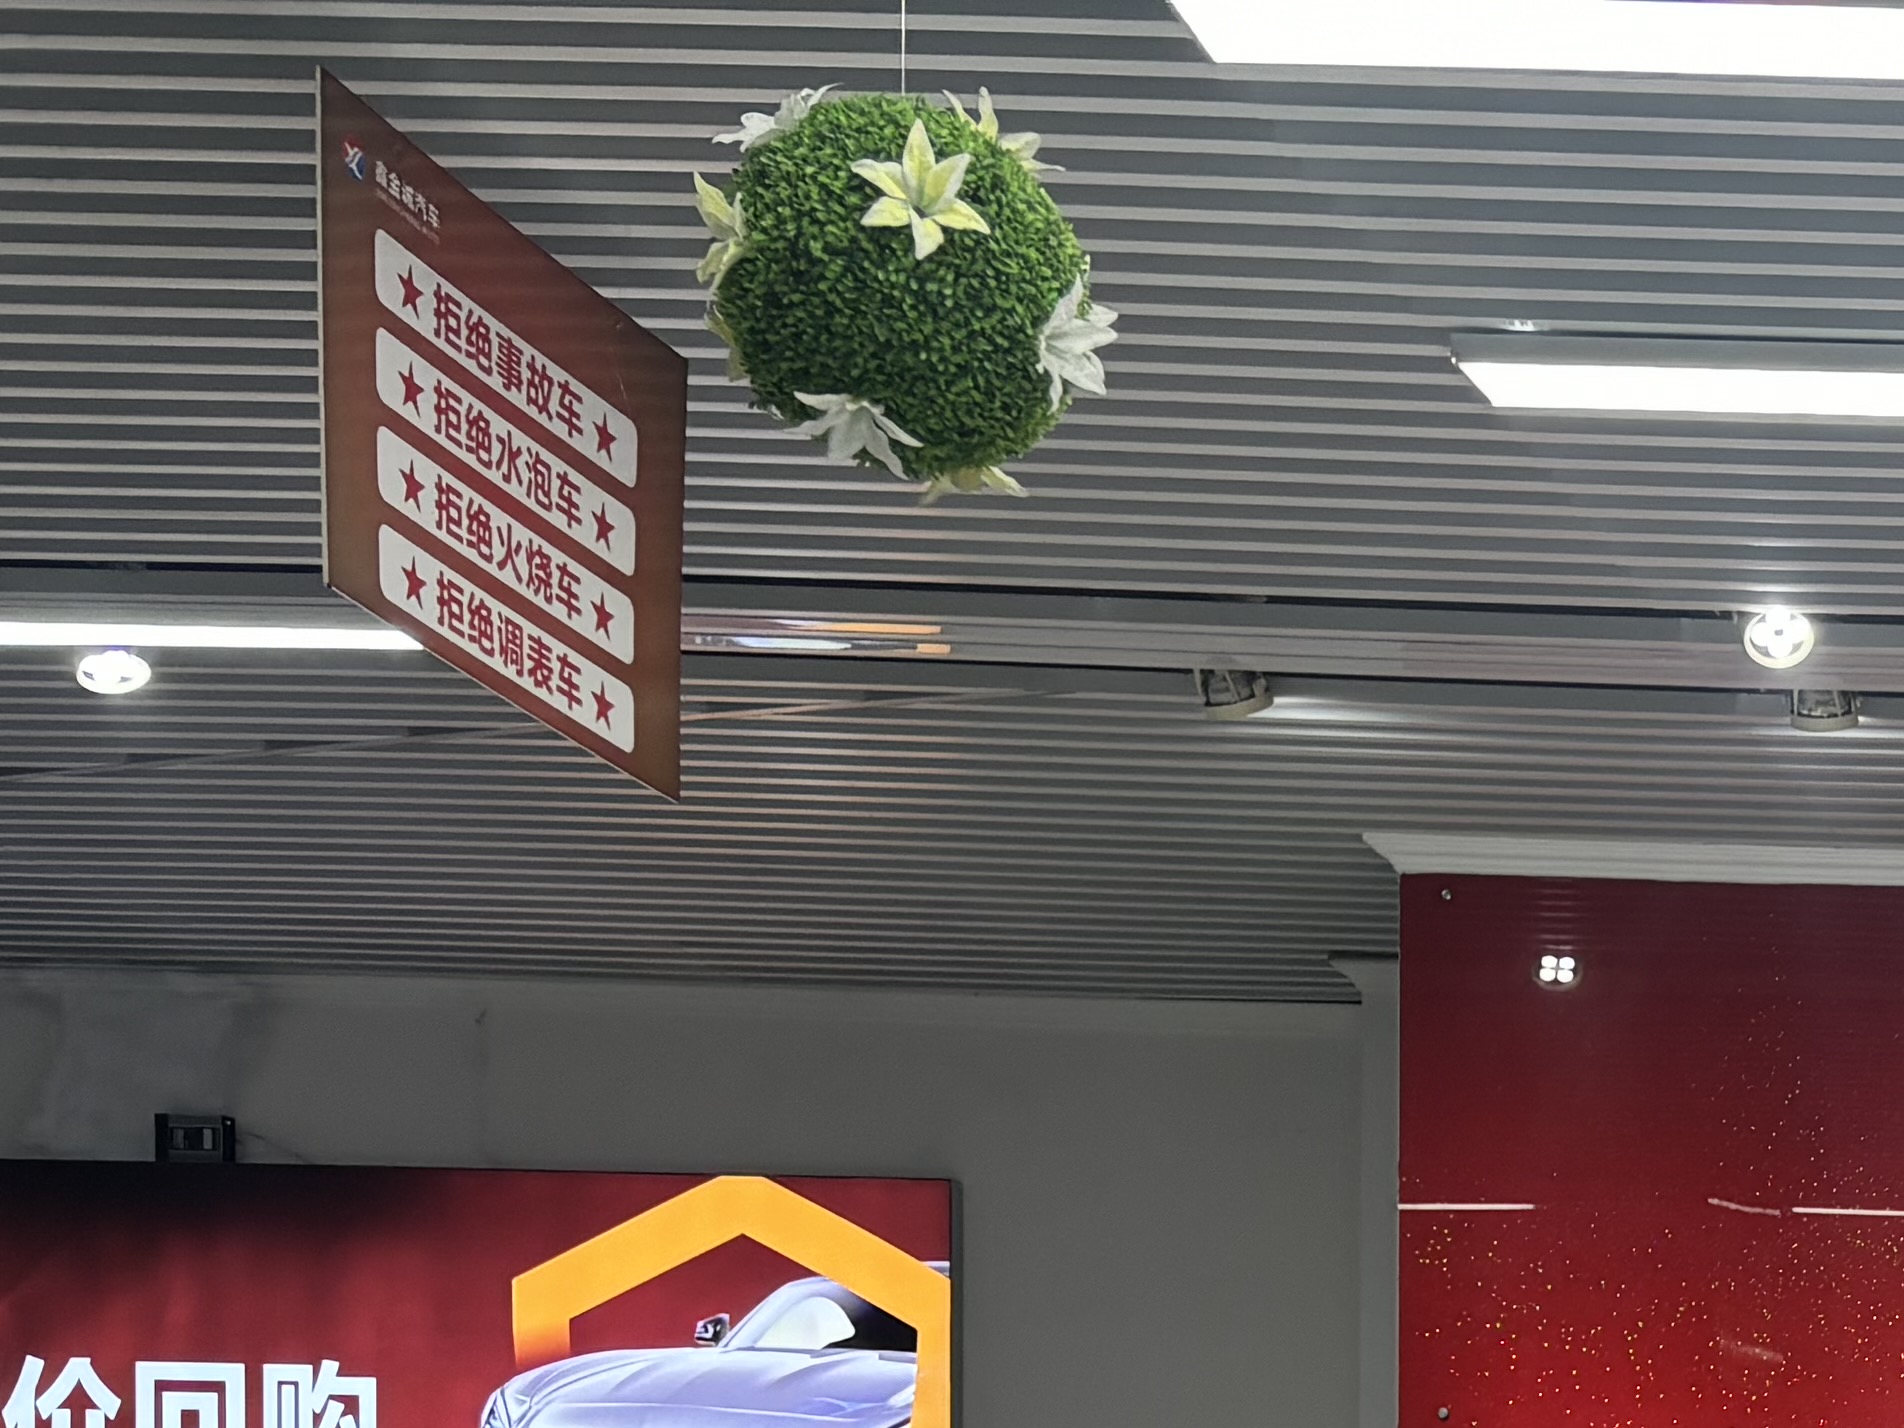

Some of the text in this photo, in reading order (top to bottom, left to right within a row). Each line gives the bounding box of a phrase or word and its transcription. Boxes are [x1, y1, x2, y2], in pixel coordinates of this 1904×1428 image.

[433, 282, 583, 438] 拒绝事故车
[433, 378, 583, 529] 拒绝水泡车
[434, 473, 583, 620] 拒绝火烧车
[436, 570, 583, 711] 拒绝调表车
